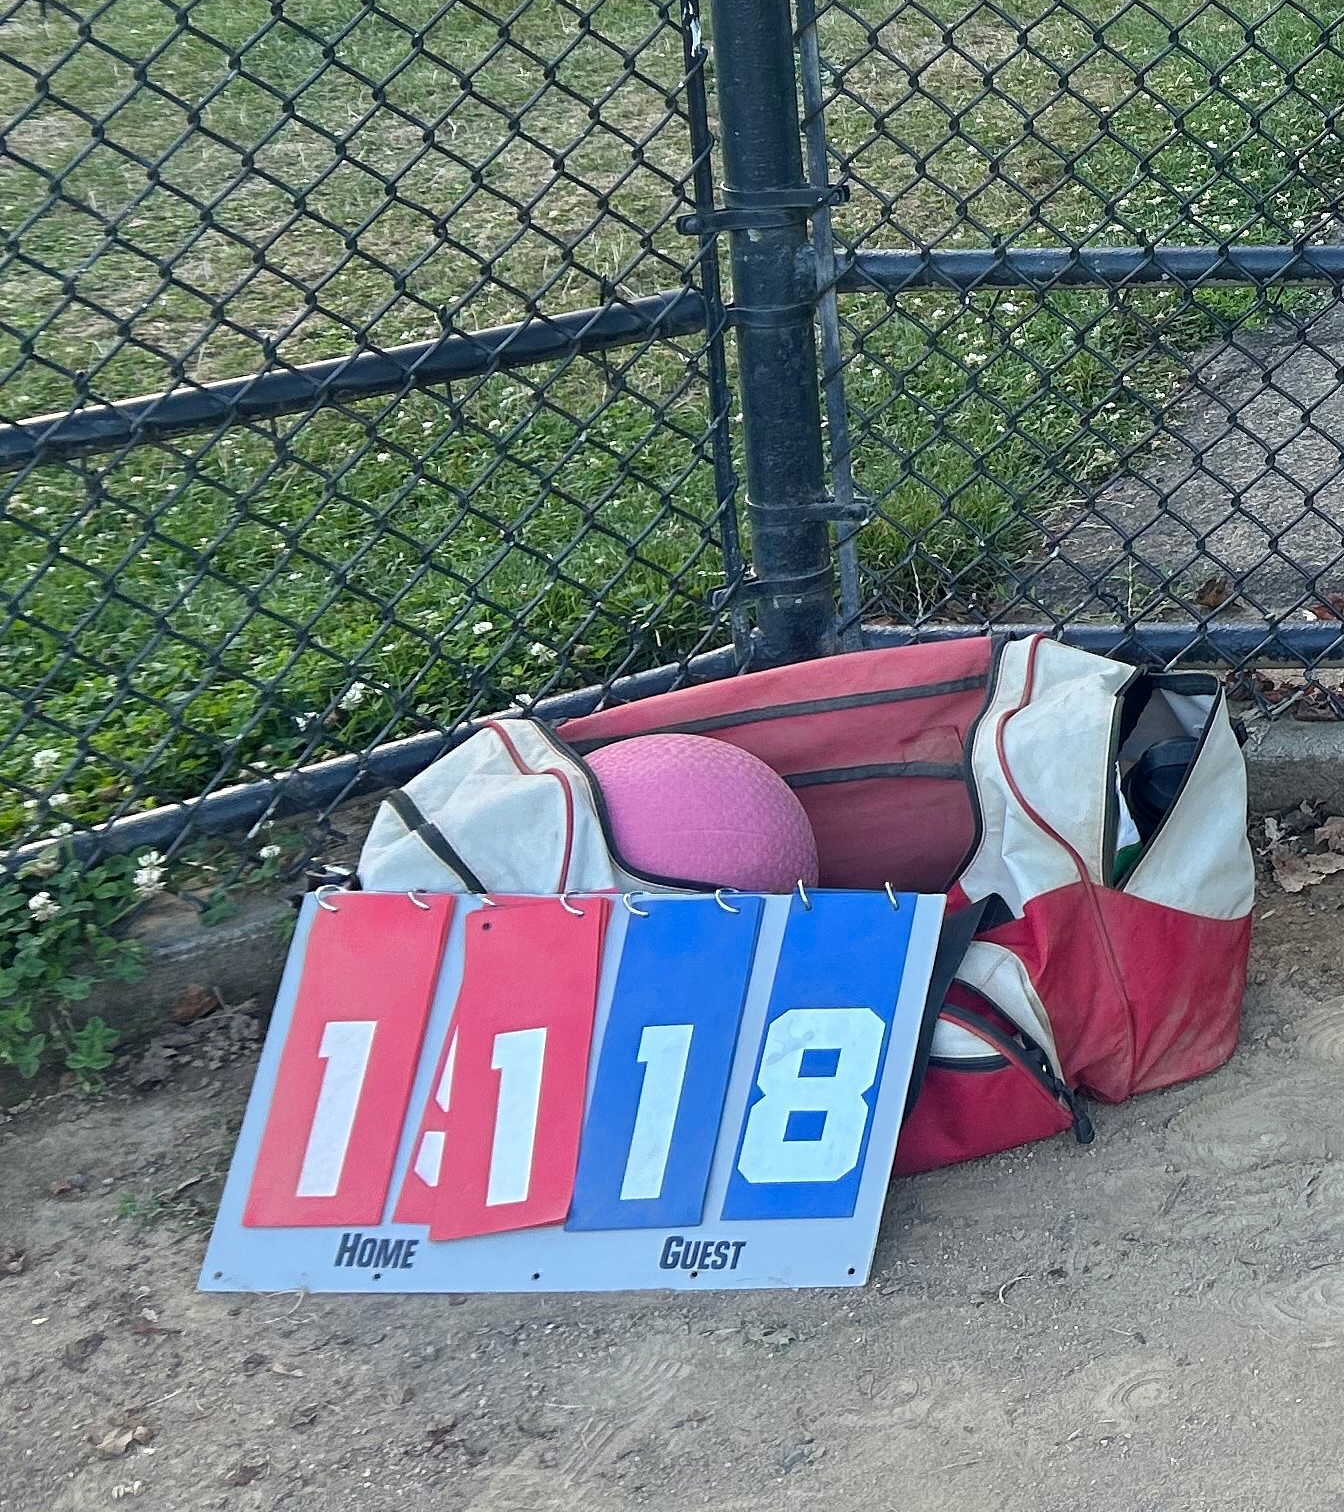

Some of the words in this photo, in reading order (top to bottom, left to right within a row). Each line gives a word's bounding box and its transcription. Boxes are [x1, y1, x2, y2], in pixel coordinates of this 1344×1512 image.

[296, 1020, 375, 1198] 1
[485, 1026, 548, 1208] 1
[619, 1024, 694, 1201] 1
[737, 1007, 886, 1185] 8
[334, 1232, 420, 1269] HOME
[659, 1235, 747, 1270] GUEST
